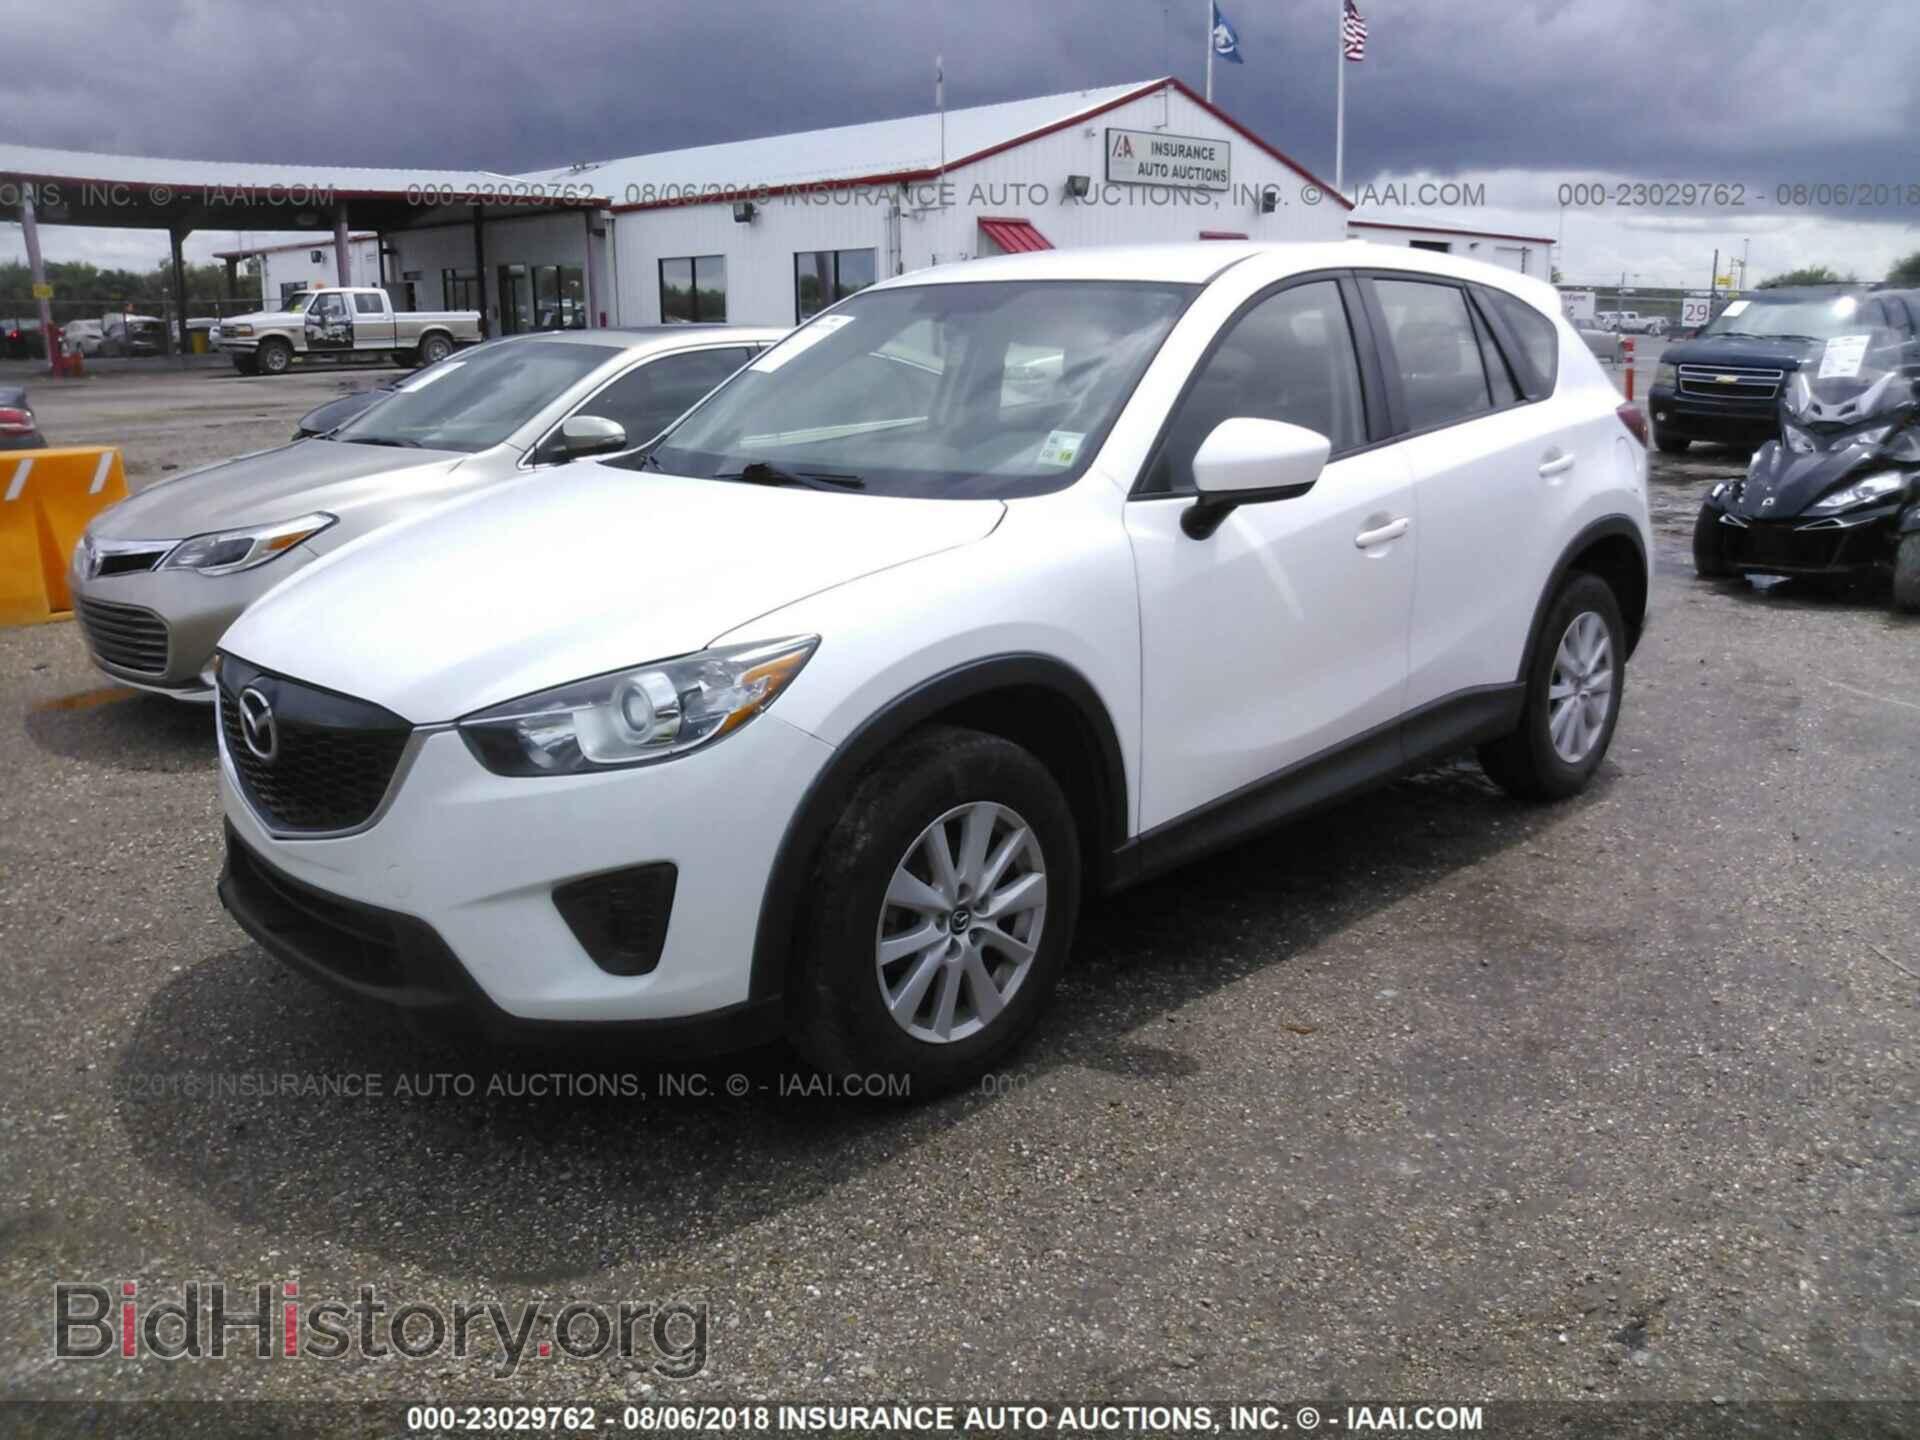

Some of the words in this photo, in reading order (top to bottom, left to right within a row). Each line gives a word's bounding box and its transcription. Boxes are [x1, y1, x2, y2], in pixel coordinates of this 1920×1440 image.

[1151, 142, 1216, 161] INSURANCE
[1138, 162, 1169, 178] AUTO
[1171, 165, 1228, 183] AUCTIONS
[1684, 303, 1708, 322] 29
